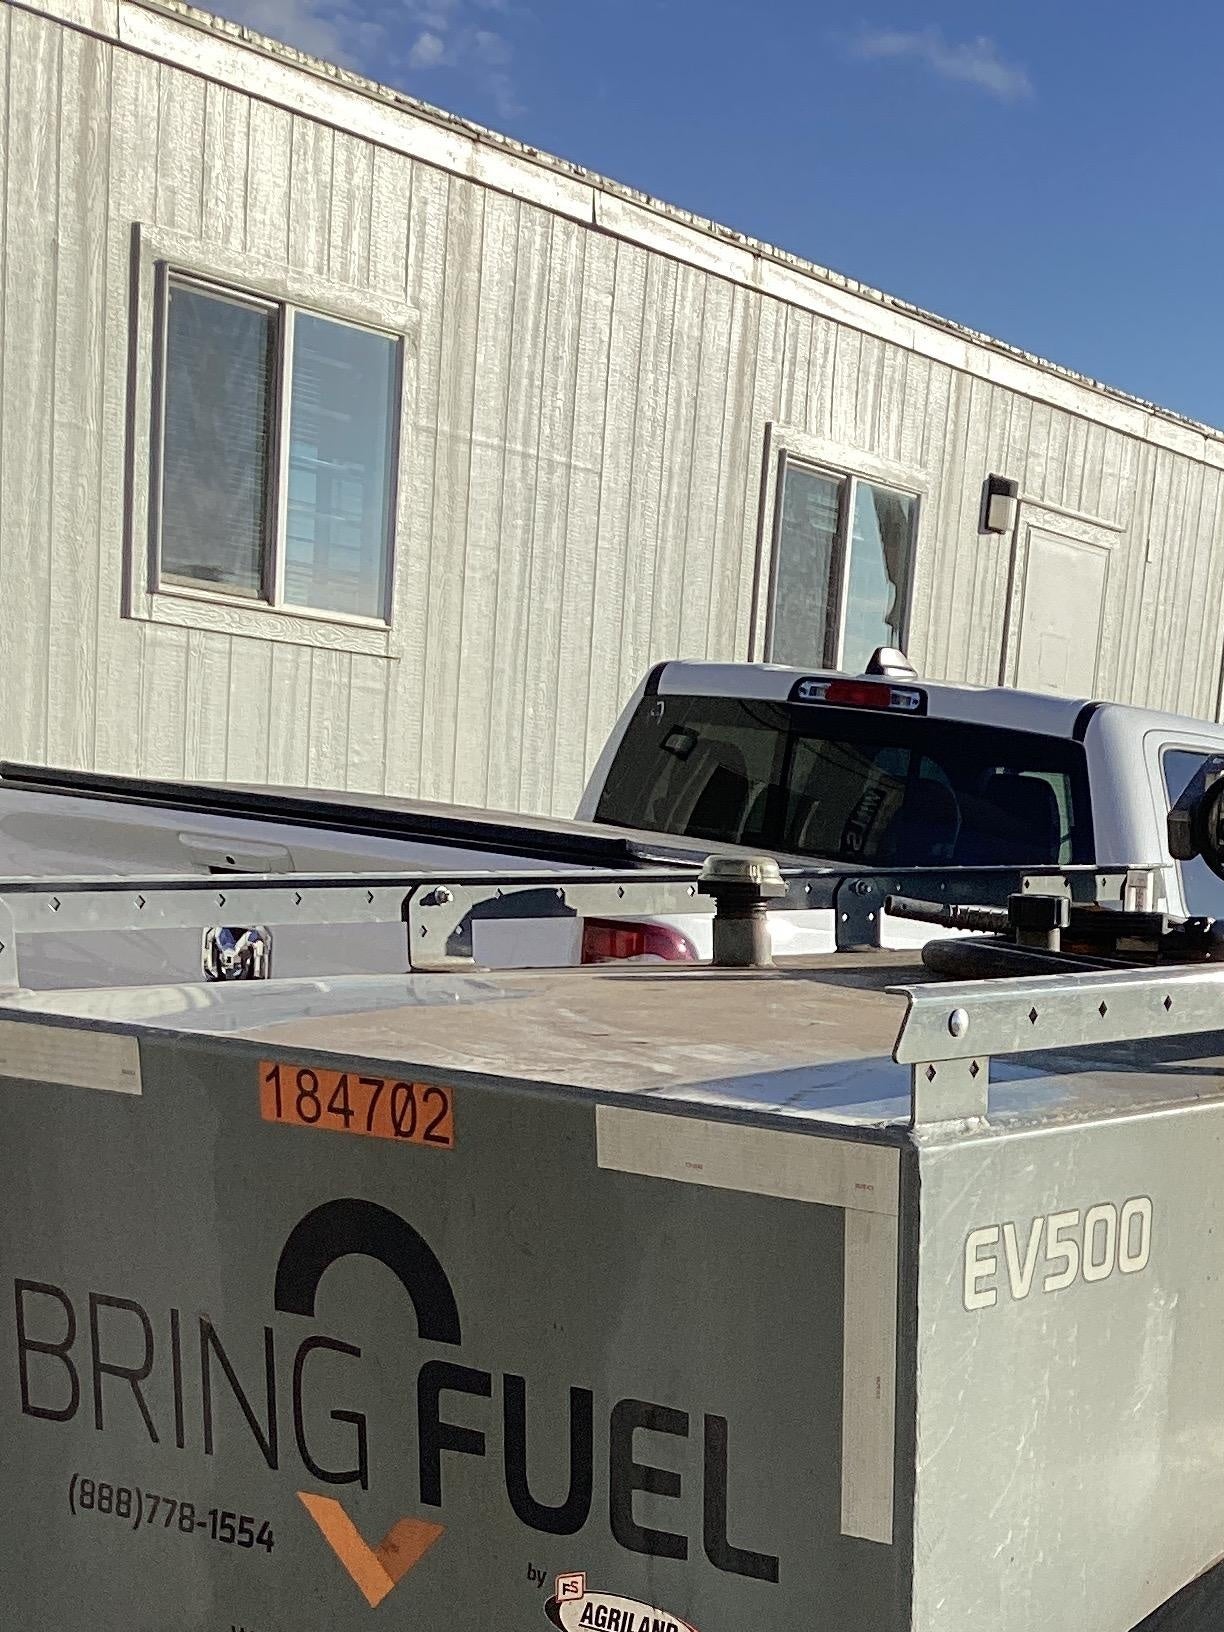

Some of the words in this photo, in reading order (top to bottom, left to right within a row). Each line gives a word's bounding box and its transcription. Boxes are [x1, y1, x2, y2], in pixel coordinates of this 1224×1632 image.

[264, 1066, 452, 1145] 184702
[963, 1195, 1153, 1311] EV500
[14, 1278, 370, 1491] BRING
[417, 1360, 781, 1584] FUEL
[68, 1473, 276, 1554] (888)778-1554
[526, 1562, 547, 1589] by
